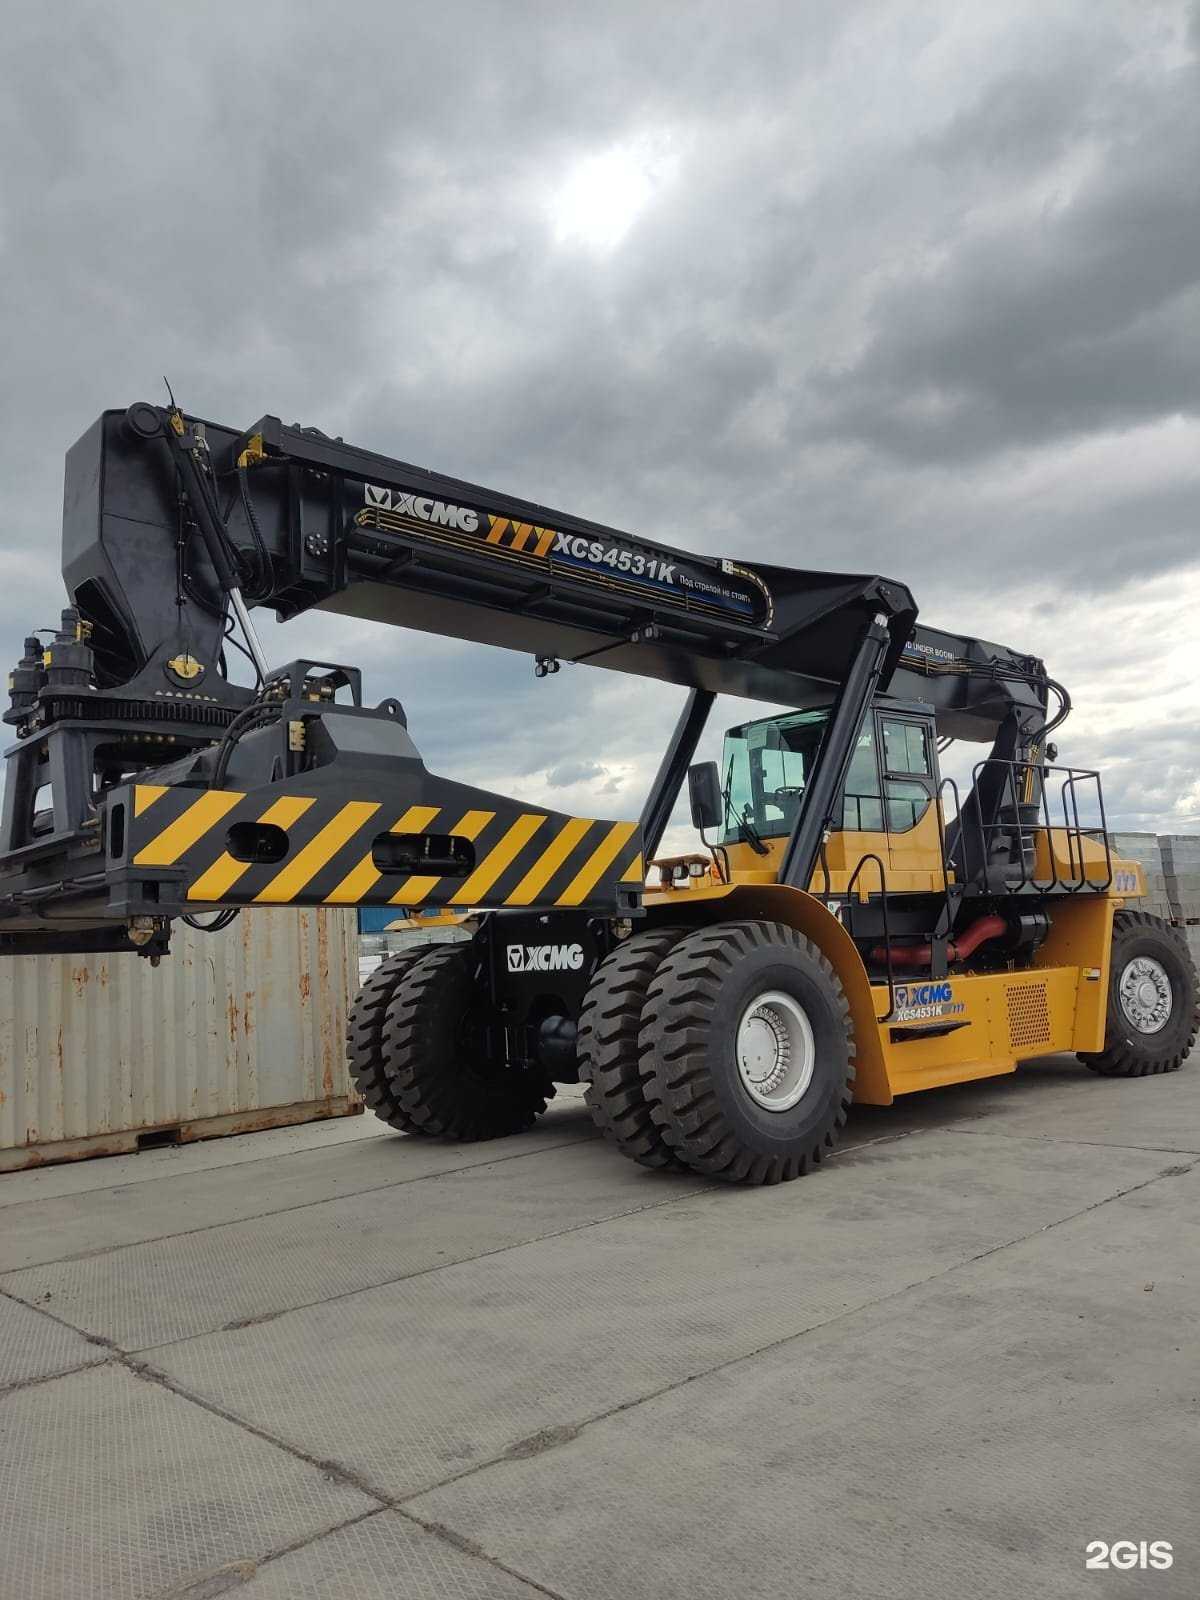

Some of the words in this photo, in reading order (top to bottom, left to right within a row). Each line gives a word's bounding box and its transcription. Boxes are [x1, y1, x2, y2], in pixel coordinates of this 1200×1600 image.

[391, 491, 479, 532] XCMG
[552, 532, 676, 585] XCS4531K
[679, 574, 694, 589] Под
[524, 943, 584, 971] XCMG
[910, 982, 953, 1007] XCMG
[896, 1004, 943, 1023] XCS4531K
